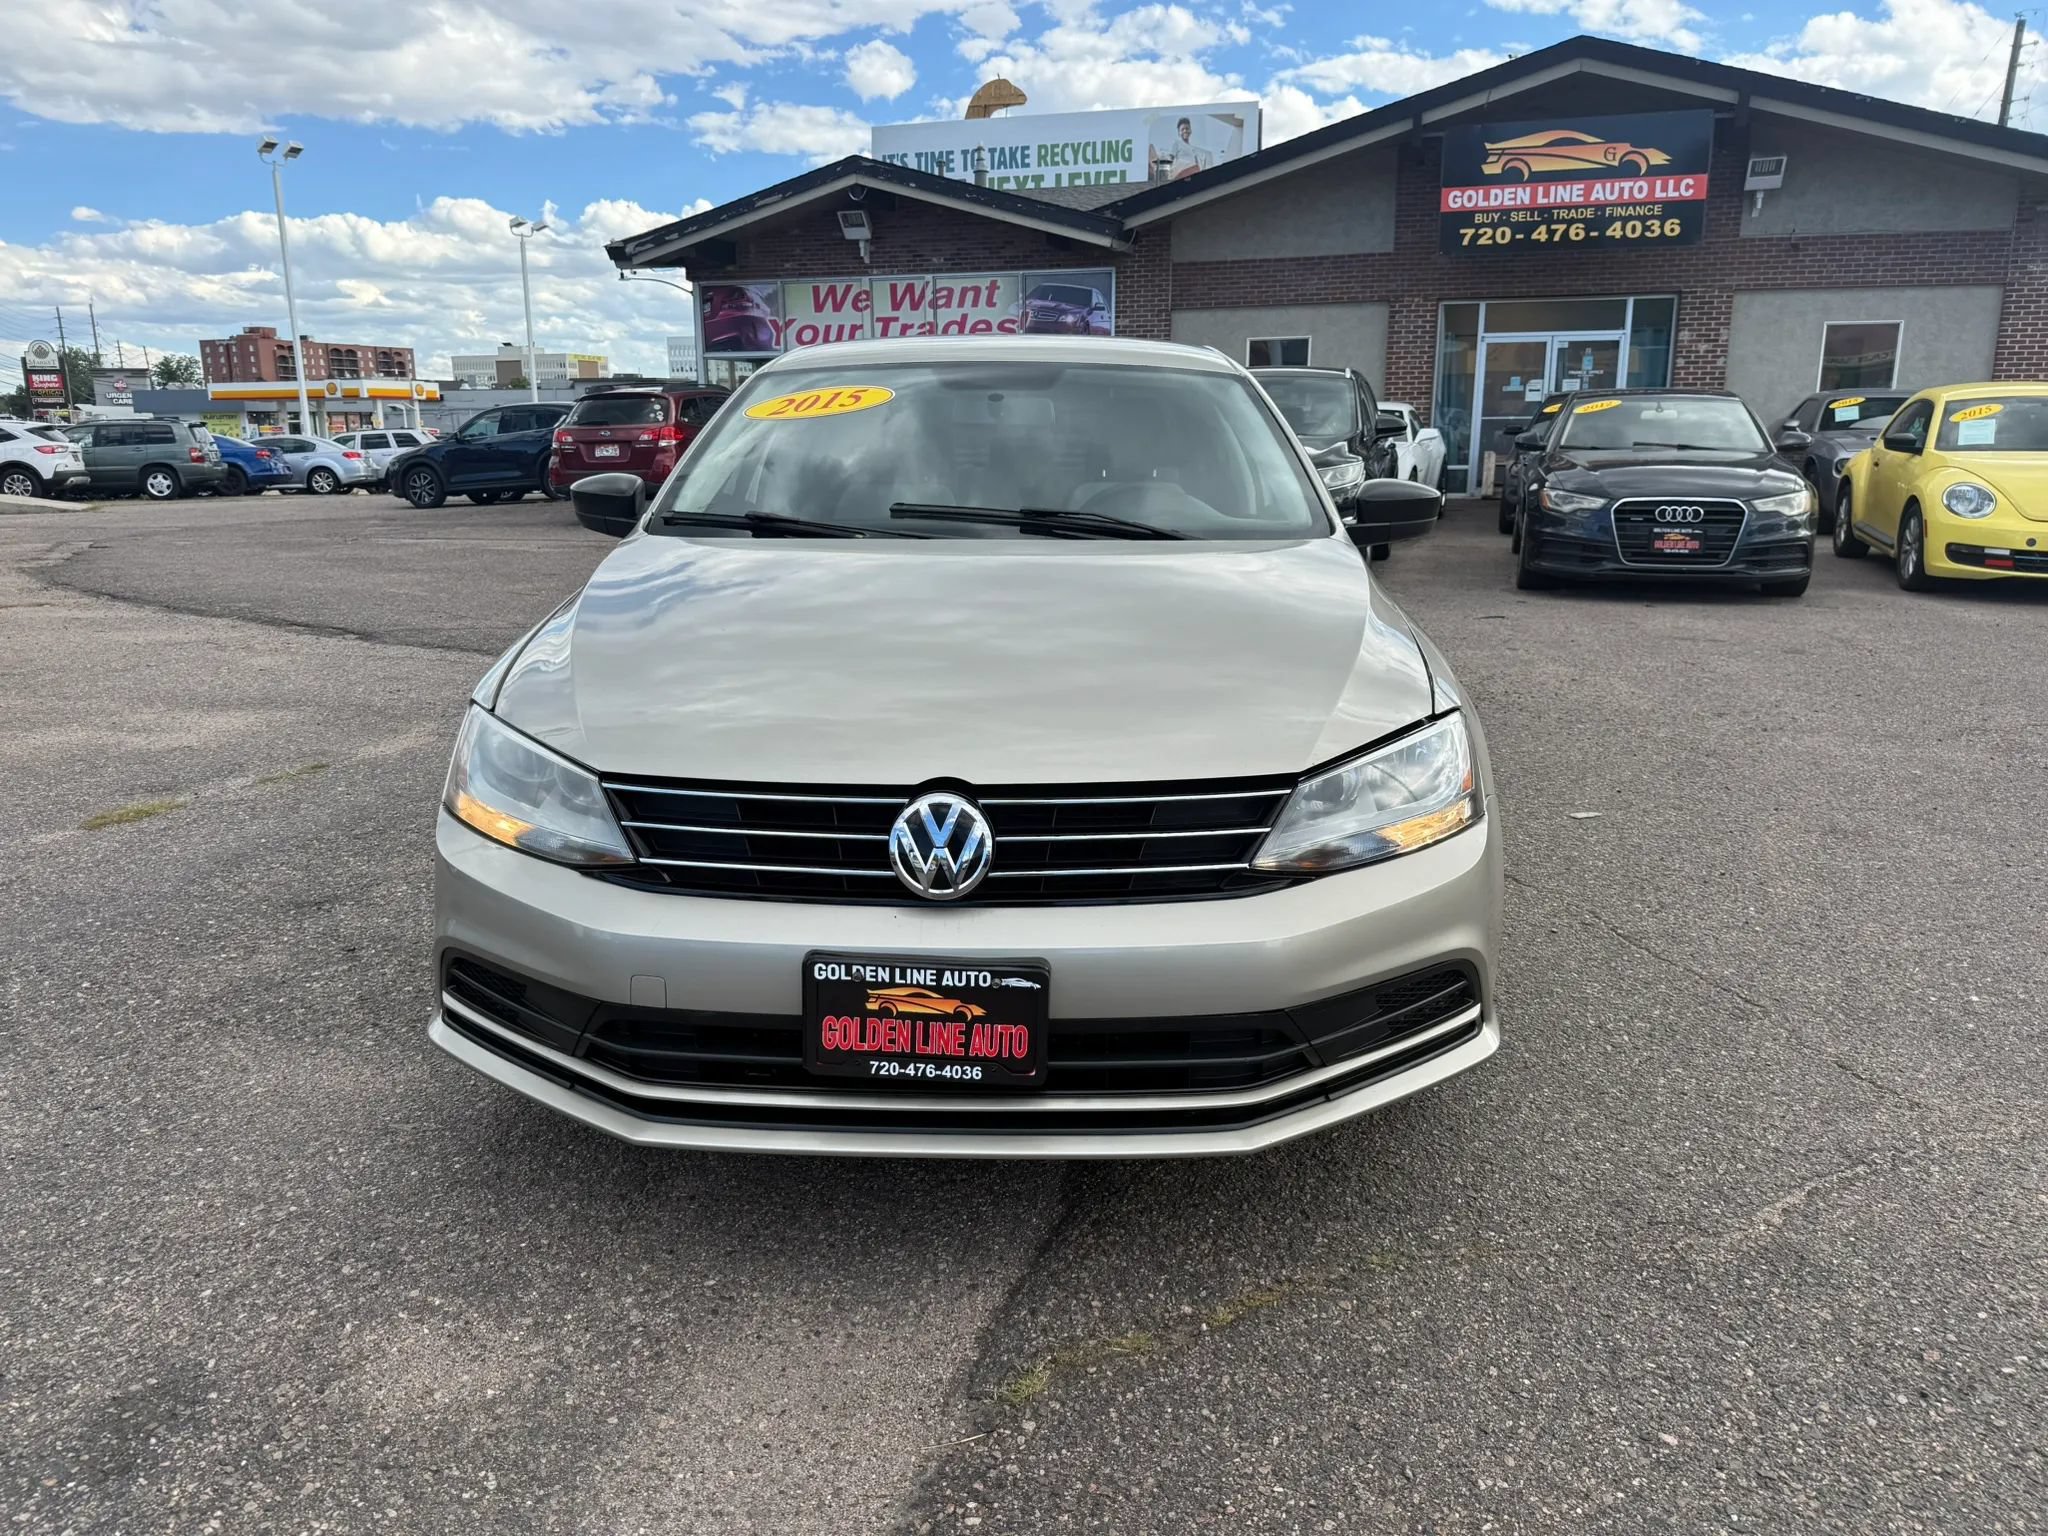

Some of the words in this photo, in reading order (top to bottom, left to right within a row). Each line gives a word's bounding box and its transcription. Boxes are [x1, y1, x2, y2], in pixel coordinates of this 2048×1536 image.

[914, 150, 955, 174] TIME
[988, 145, 1031, 170] TAKE
[1037, 139, 1133, 168] RECYCLING
[1448, 187, 1531, 209] GOLDEN
[1536, 184, 1584, 205] LINE
[1590, 180, 1648, 202] AUTO
[1654, 178, 1695, 198] LLC
[1474, 212, 1501, 224] BUY
[1510, 210, 1541, 222] SELL
[1552, 207, 1596, 220] TRADE
[1605, 204, 1663, 217] FINANCE
[811, 283, 872, 313] We
[889, 279, 1001, 312] Want
[767, 318, 864, 346] Your
[32, 374, 58, 382] KING
[766, 389, 864, 416] 2015
[1960, 405, 1993, 420] 2015
[814, 963, 890, 983] GOLDEN
[895, 968, 937, 985] LINE
[942, 970, 992, 988] AUTO
[821, 1015, 911, 1053] GOLDEN
[915, 1020, 965, 1056] LINE
[968, 1022, 1029, 1060] AUTO
[869, 1060, 982, 1080] 720-476-4036
